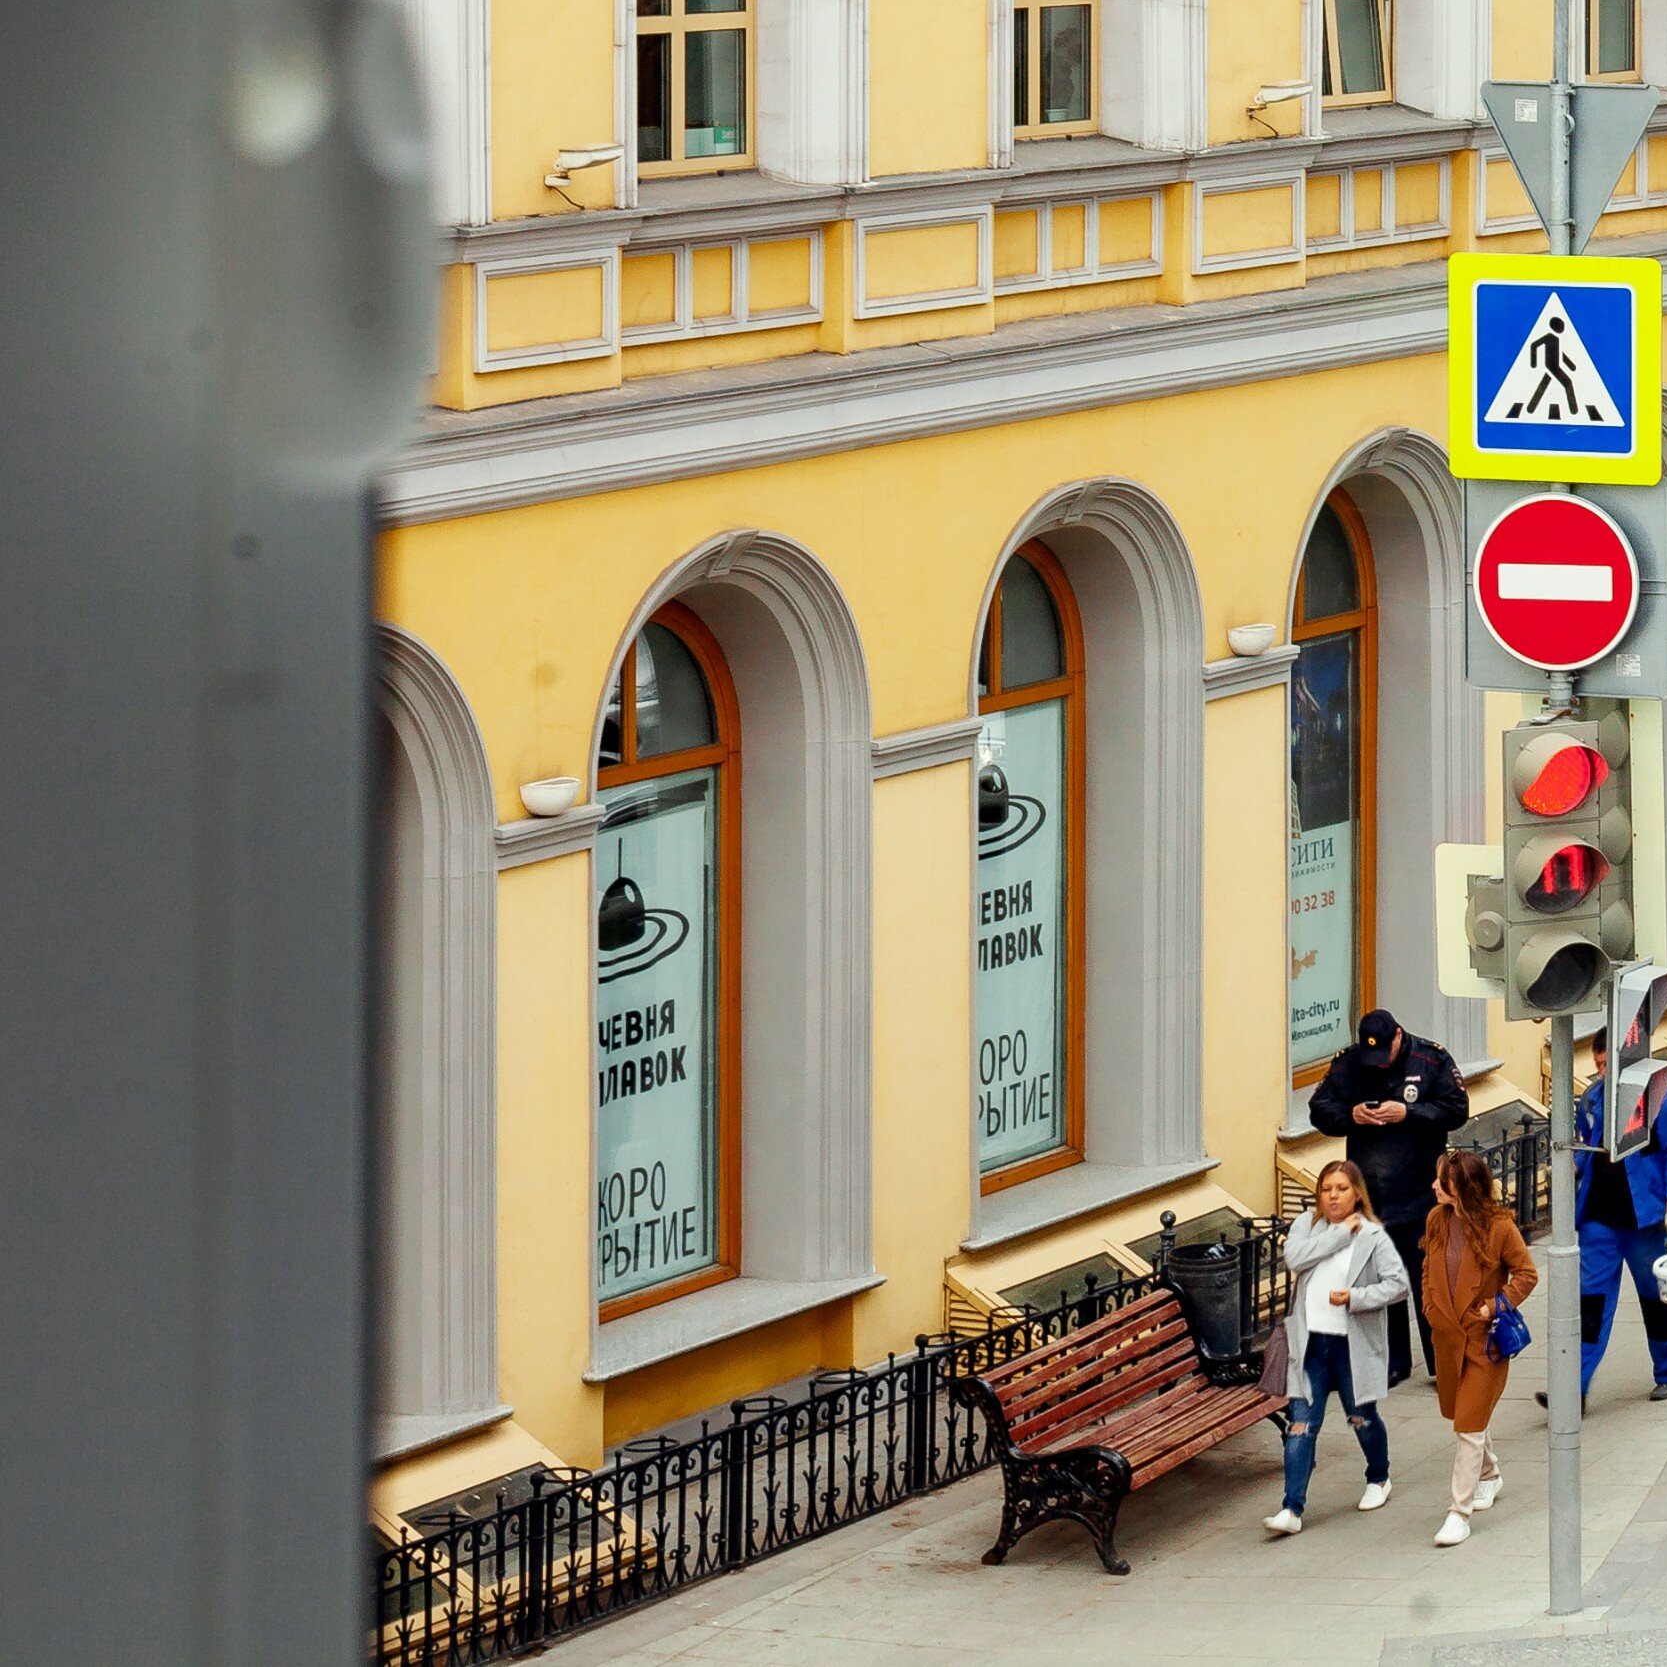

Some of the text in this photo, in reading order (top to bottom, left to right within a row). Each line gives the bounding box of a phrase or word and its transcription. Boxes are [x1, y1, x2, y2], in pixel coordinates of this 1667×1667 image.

[978, 880, 1032, 926] ЕВНЯ
[1303, 894, 1318, 912] 32
[598, 1205, 696, 1288] РЫТИЕ
